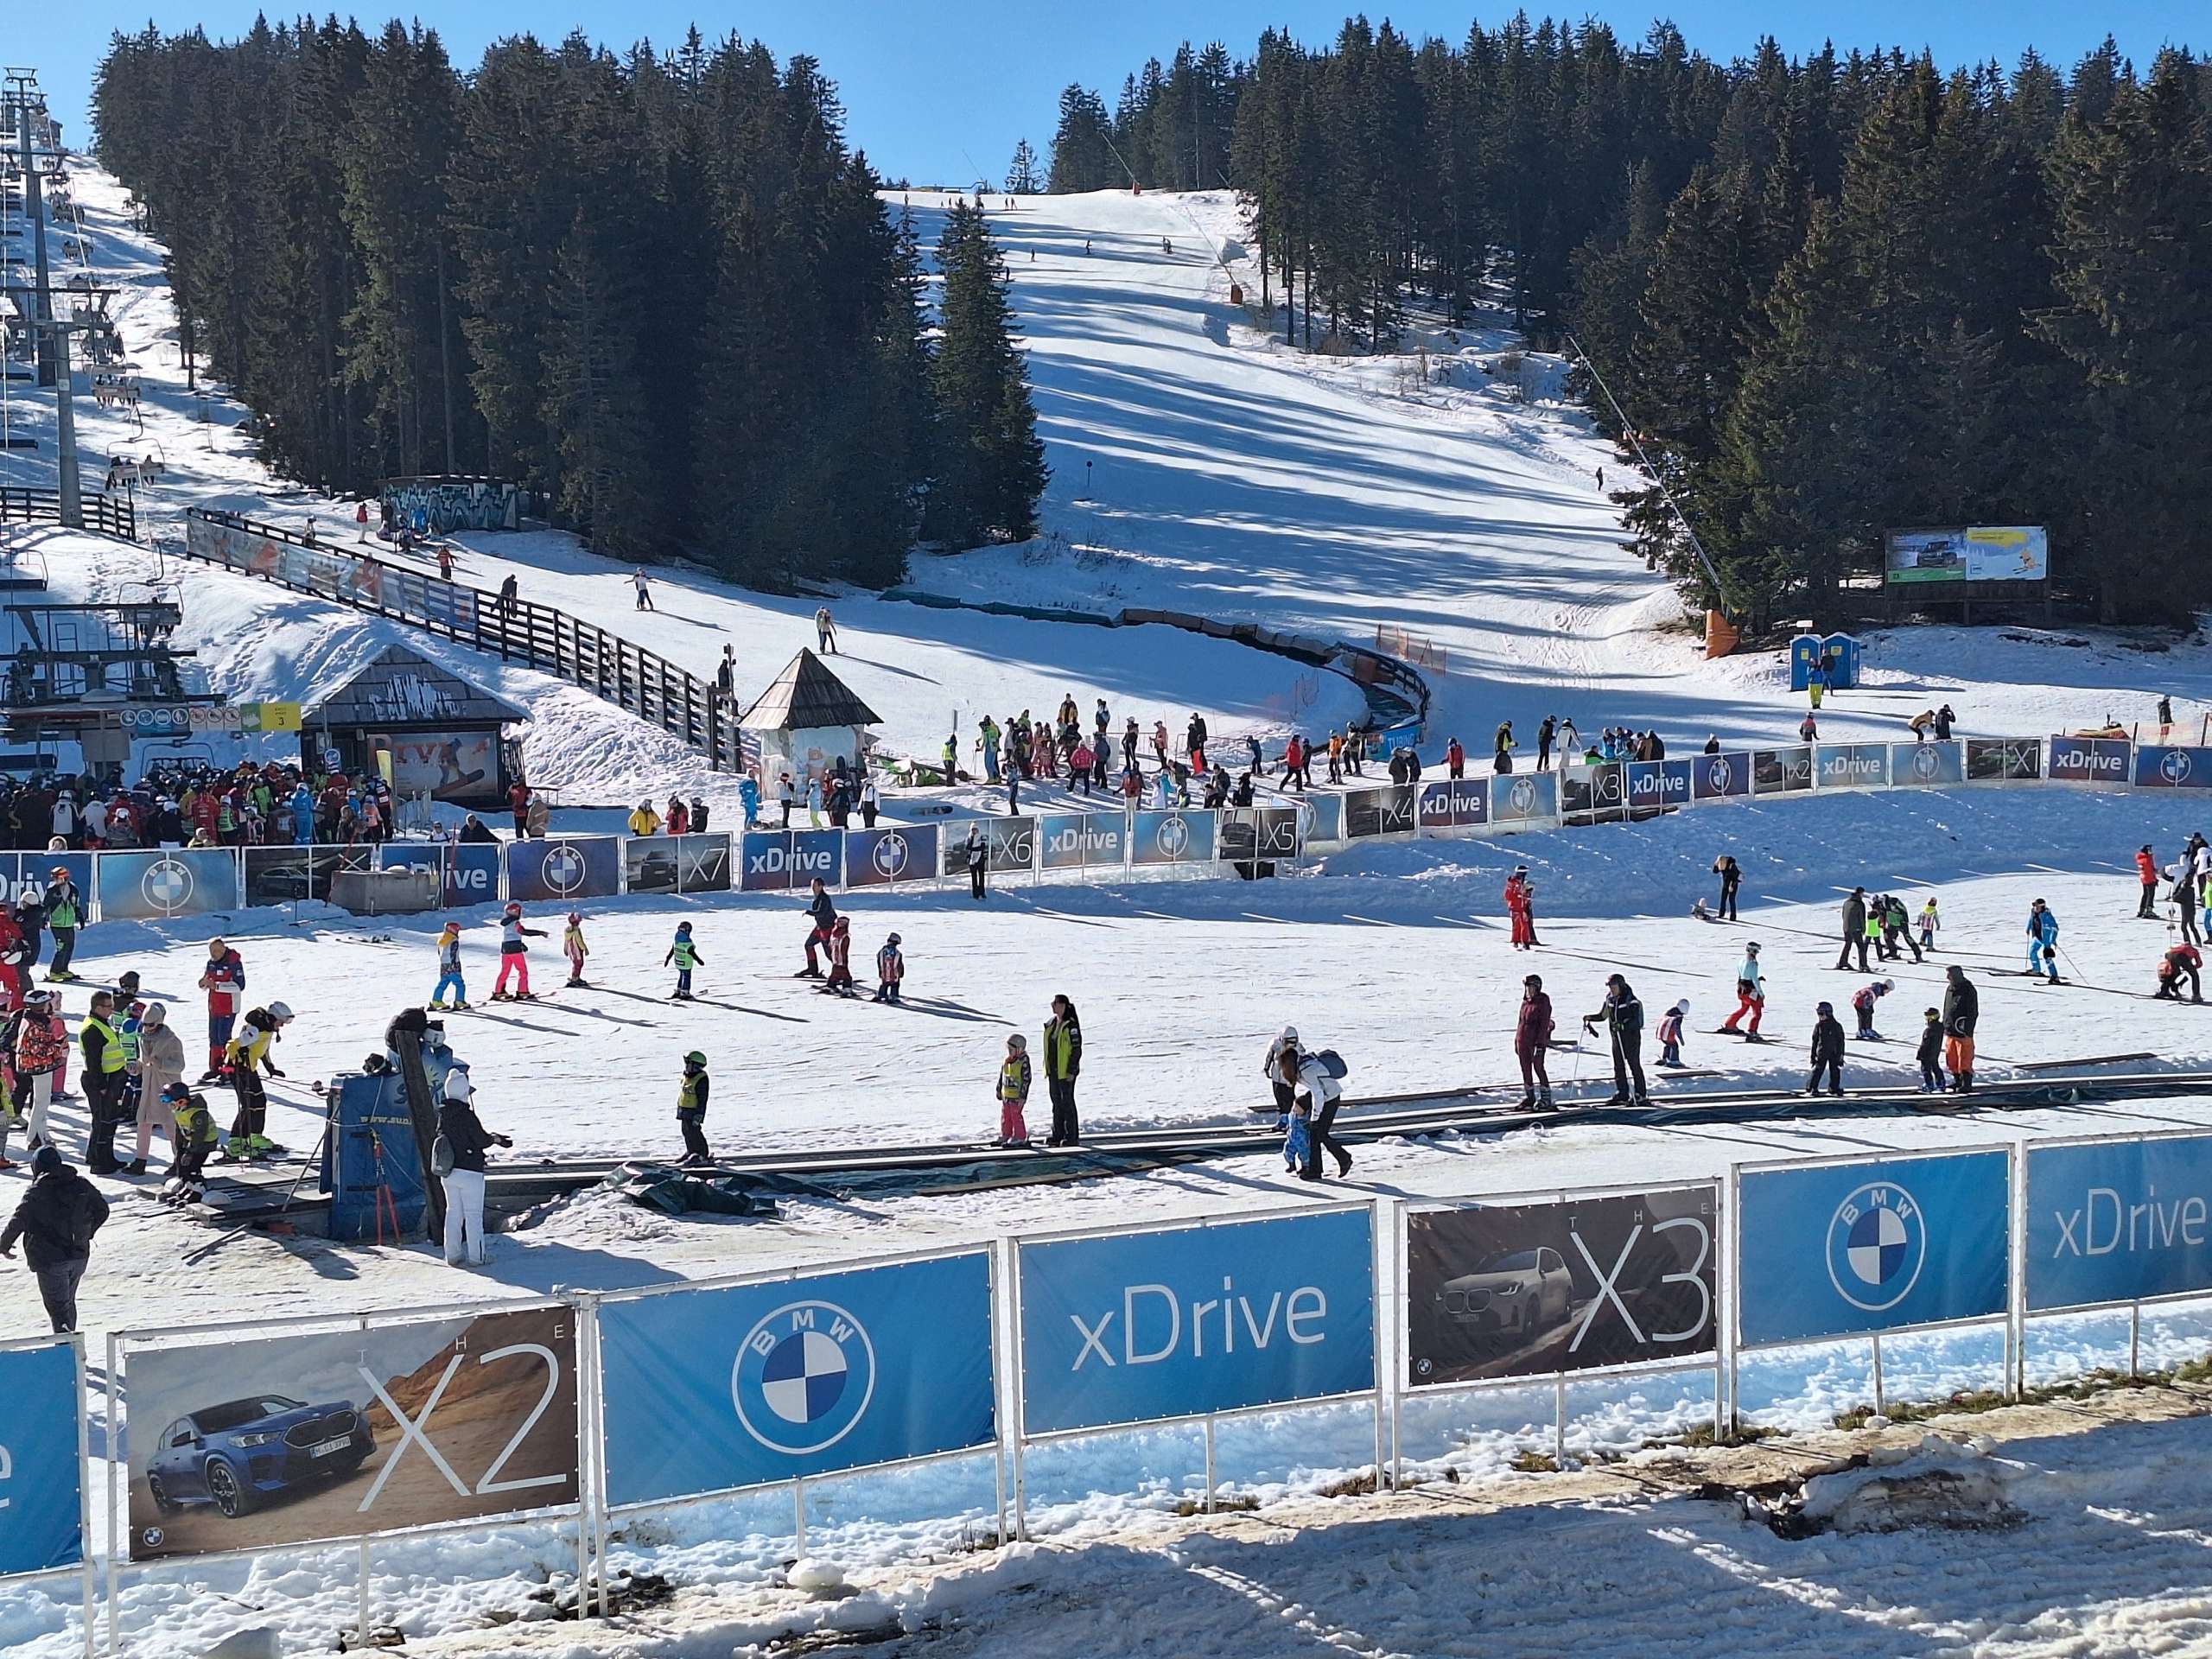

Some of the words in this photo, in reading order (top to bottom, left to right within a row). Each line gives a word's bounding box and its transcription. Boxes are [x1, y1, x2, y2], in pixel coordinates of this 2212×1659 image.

[1824, 755, 1881, 776] xDrive
[2012, 746, 2039, 773] X1
[2056, 750, 2123, 771] xDrive
[1595, 773, 1619, 802] X3
[1633, 773, 1684, 794] xDrive
[1386, 798, 1414, 825] X4
[1422, 792, 1481, 815] xDrive
[998, 831, 1033, 864] X6
[1049, 827, 1118, 853] xDrive
[1264, 822, 1295, 851] X5
[687, 848, 727, 883] X7
[750, 846, 832, 874] xDrive
[1841, 1189, 1913, 1227] BMW
[2054, 1185, 2207, 1259] xDrive
[1568, 1217, 1711, 1353] X3
[751, 1308, 855, 1357] BMW
[1070, 1275, 1327, 1371] xDrive
[357, 1342, 567, 1512] X2
